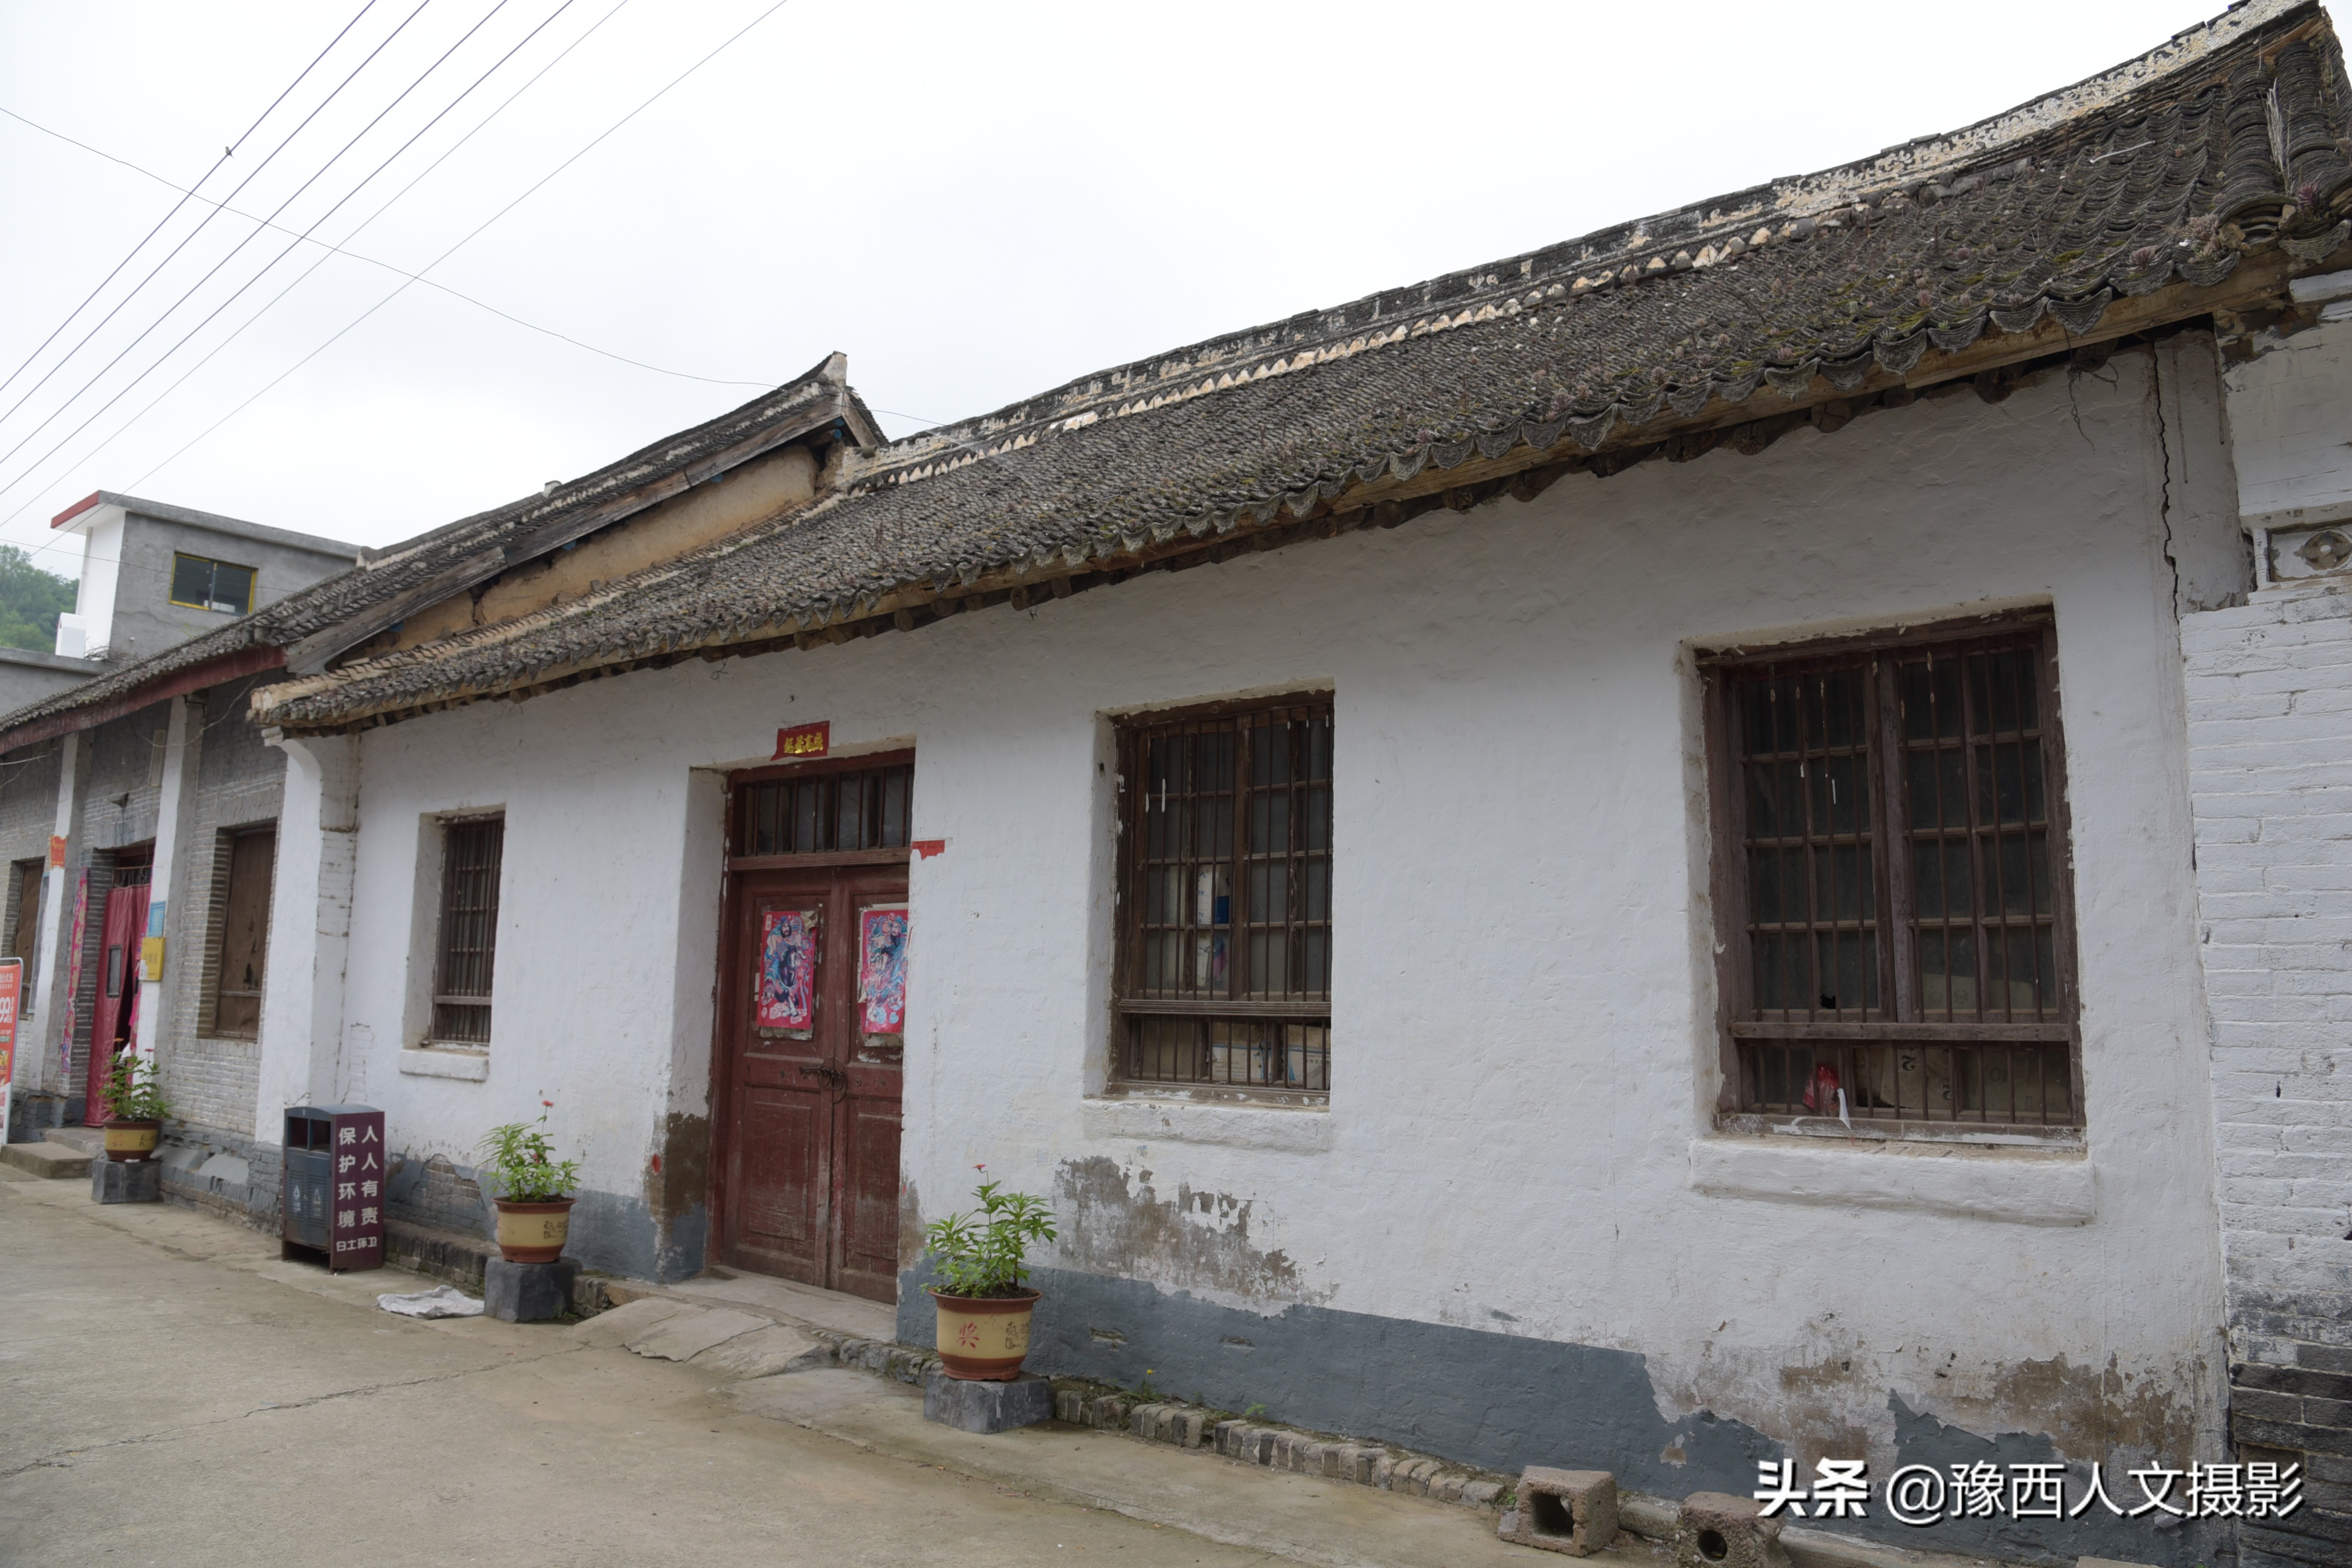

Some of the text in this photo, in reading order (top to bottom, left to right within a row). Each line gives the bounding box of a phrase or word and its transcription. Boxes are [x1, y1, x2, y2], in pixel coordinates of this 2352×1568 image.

[338, 1127, 357, 1229] 保护环境
[361, 1125, 378, 1226] 人人有责
